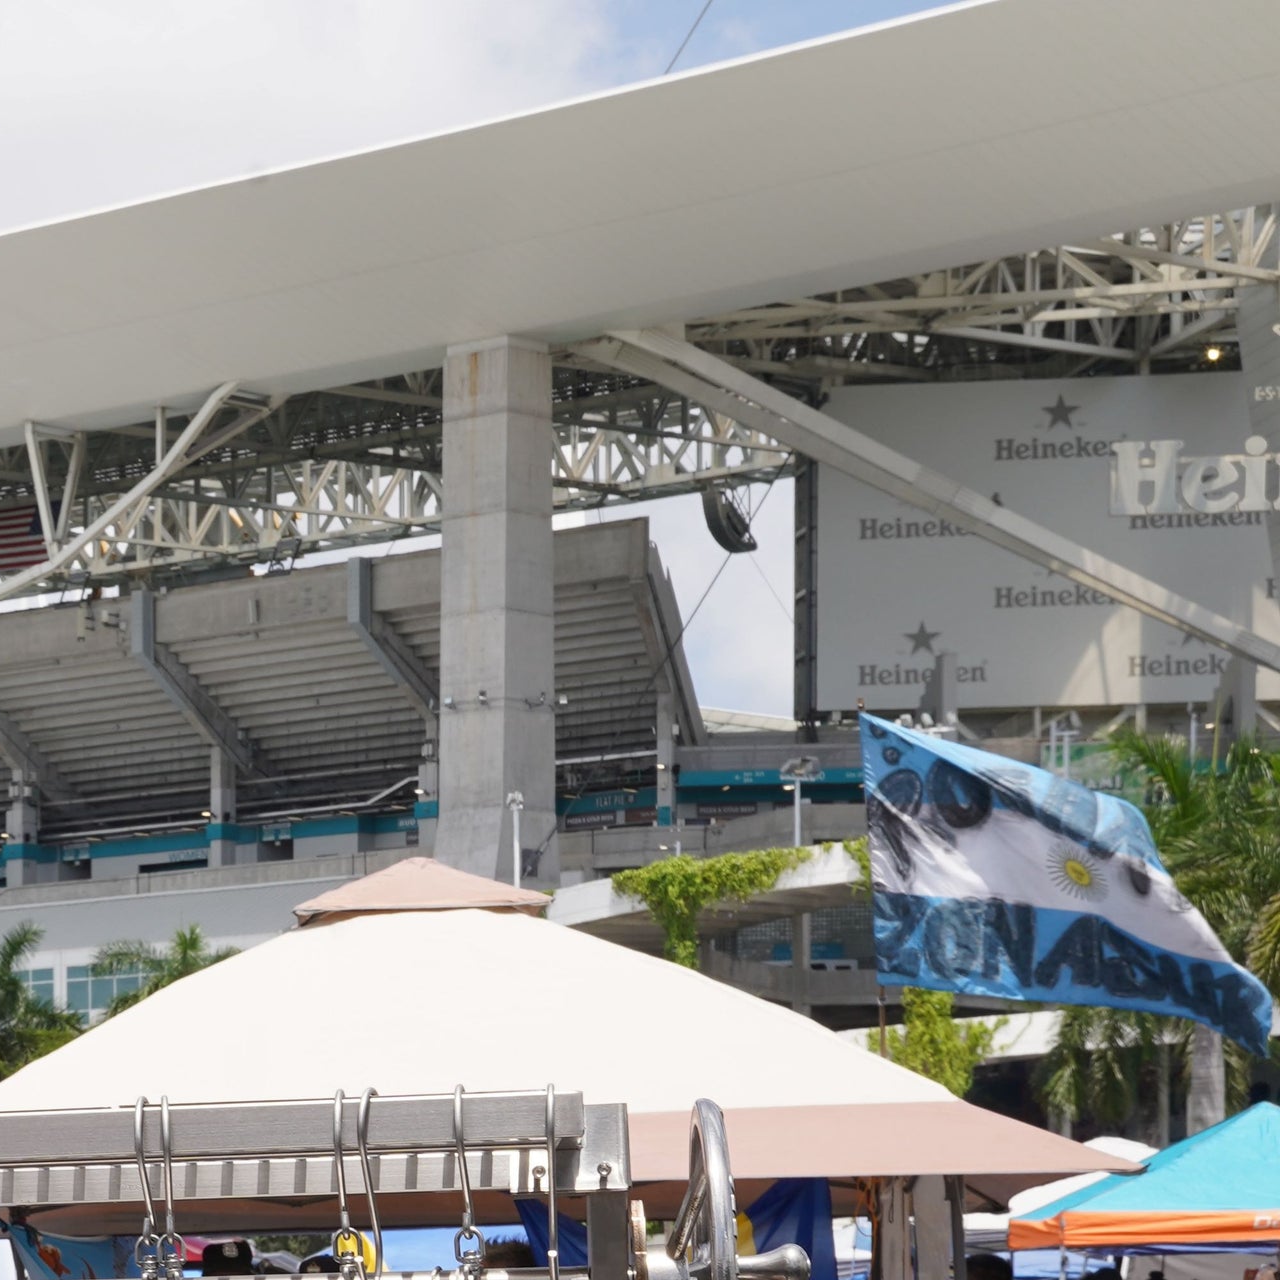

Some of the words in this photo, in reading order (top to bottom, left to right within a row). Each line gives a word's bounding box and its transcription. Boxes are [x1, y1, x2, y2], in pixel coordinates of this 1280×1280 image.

[1111, 435, 1280, 515] Hei
[858, 664, 987, 686] Heineen
[1128, 653, 1225, 678] Heinek
